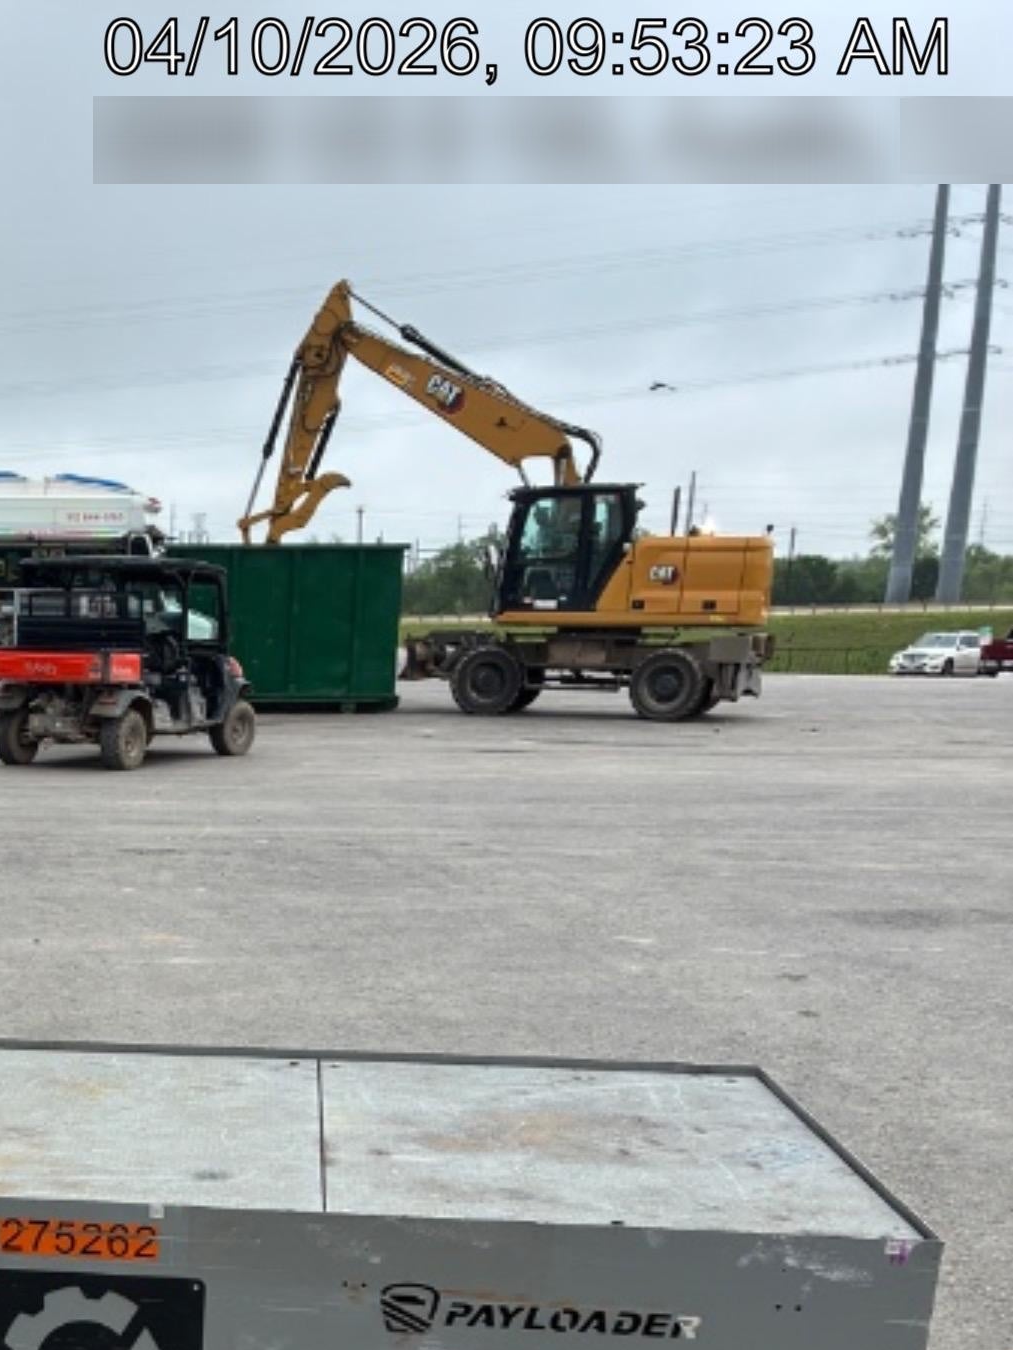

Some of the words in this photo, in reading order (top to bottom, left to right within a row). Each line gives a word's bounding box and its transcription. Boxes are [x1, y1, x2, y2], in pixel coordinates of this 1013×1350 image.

[427, 375, 462, 406] CAT
[650, 565, 675, 583] CAT
[1, 1217, 157, 1258] 275262
[444, 1301, 702, 1340] PAYLOADER
